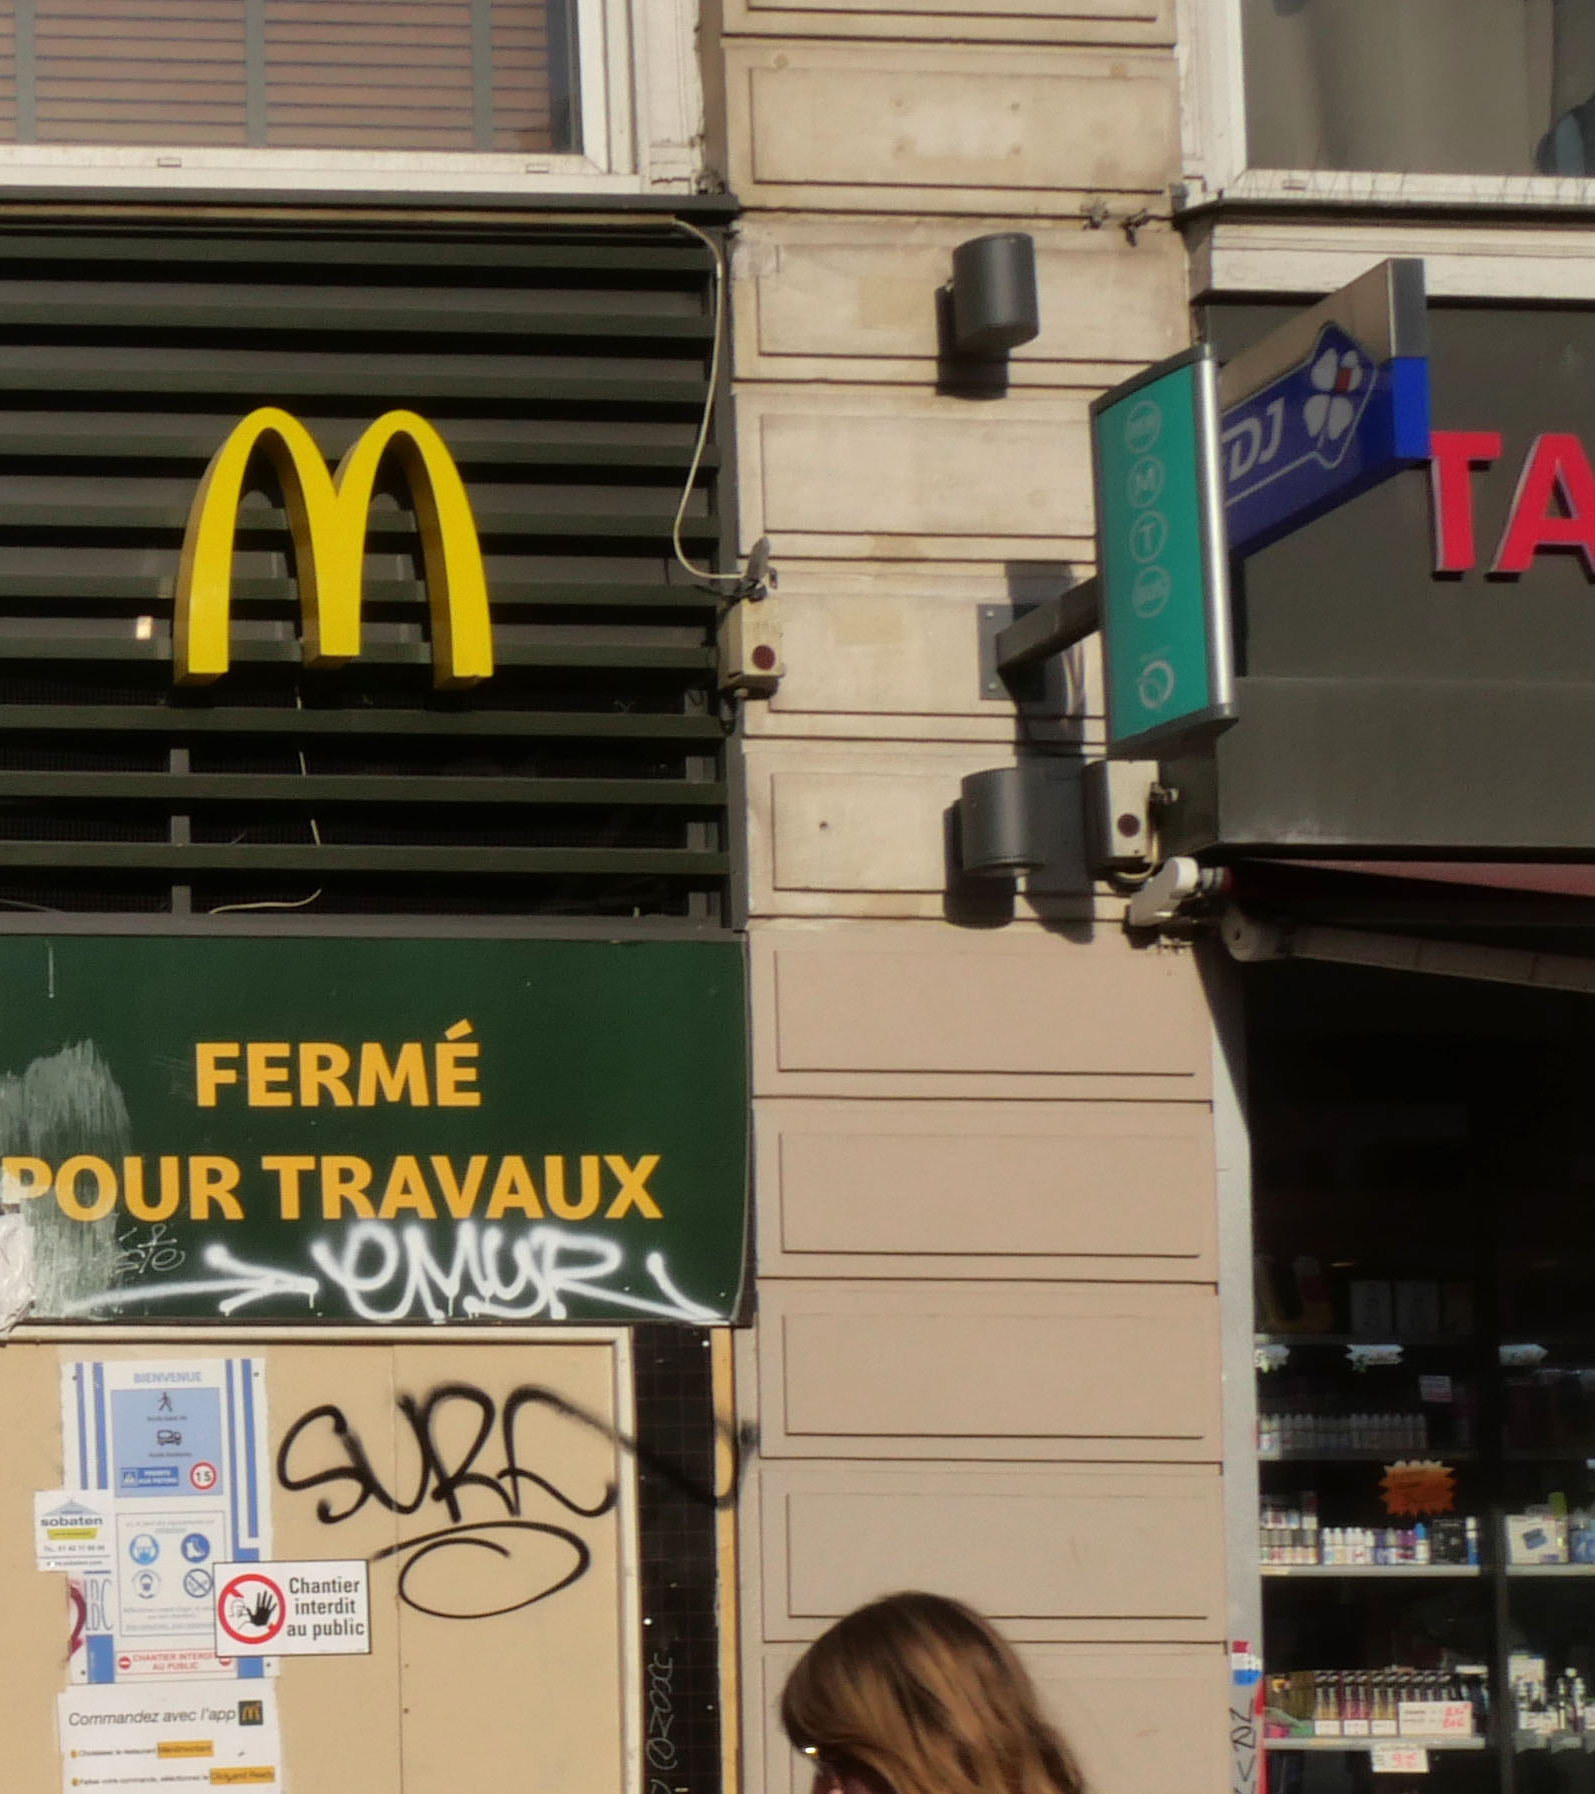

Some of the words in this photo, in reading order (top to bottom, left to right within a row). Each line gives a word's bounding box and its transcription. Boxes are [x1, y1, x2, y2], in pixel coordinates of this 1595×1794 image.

[195, 1018, 481, 1108] FERMÉ
[1, 1154, 244, 1222] POUR
[262, 1154, 662, 1221] TRAVAUX
[133, 1370, 202, 1384] BIENVENUE
[40, 1514, 104, 1528] sobaten
[289, 1577, 360, 1596] Chantier
[294, 1597, 357, 1617] interdit
[287, 1621, 308, 1638] au
[312, 1618, 364, 1641] public
[68, 1711, 159, 1727] Commandez
[162, 1710, 197, 1723] avec
